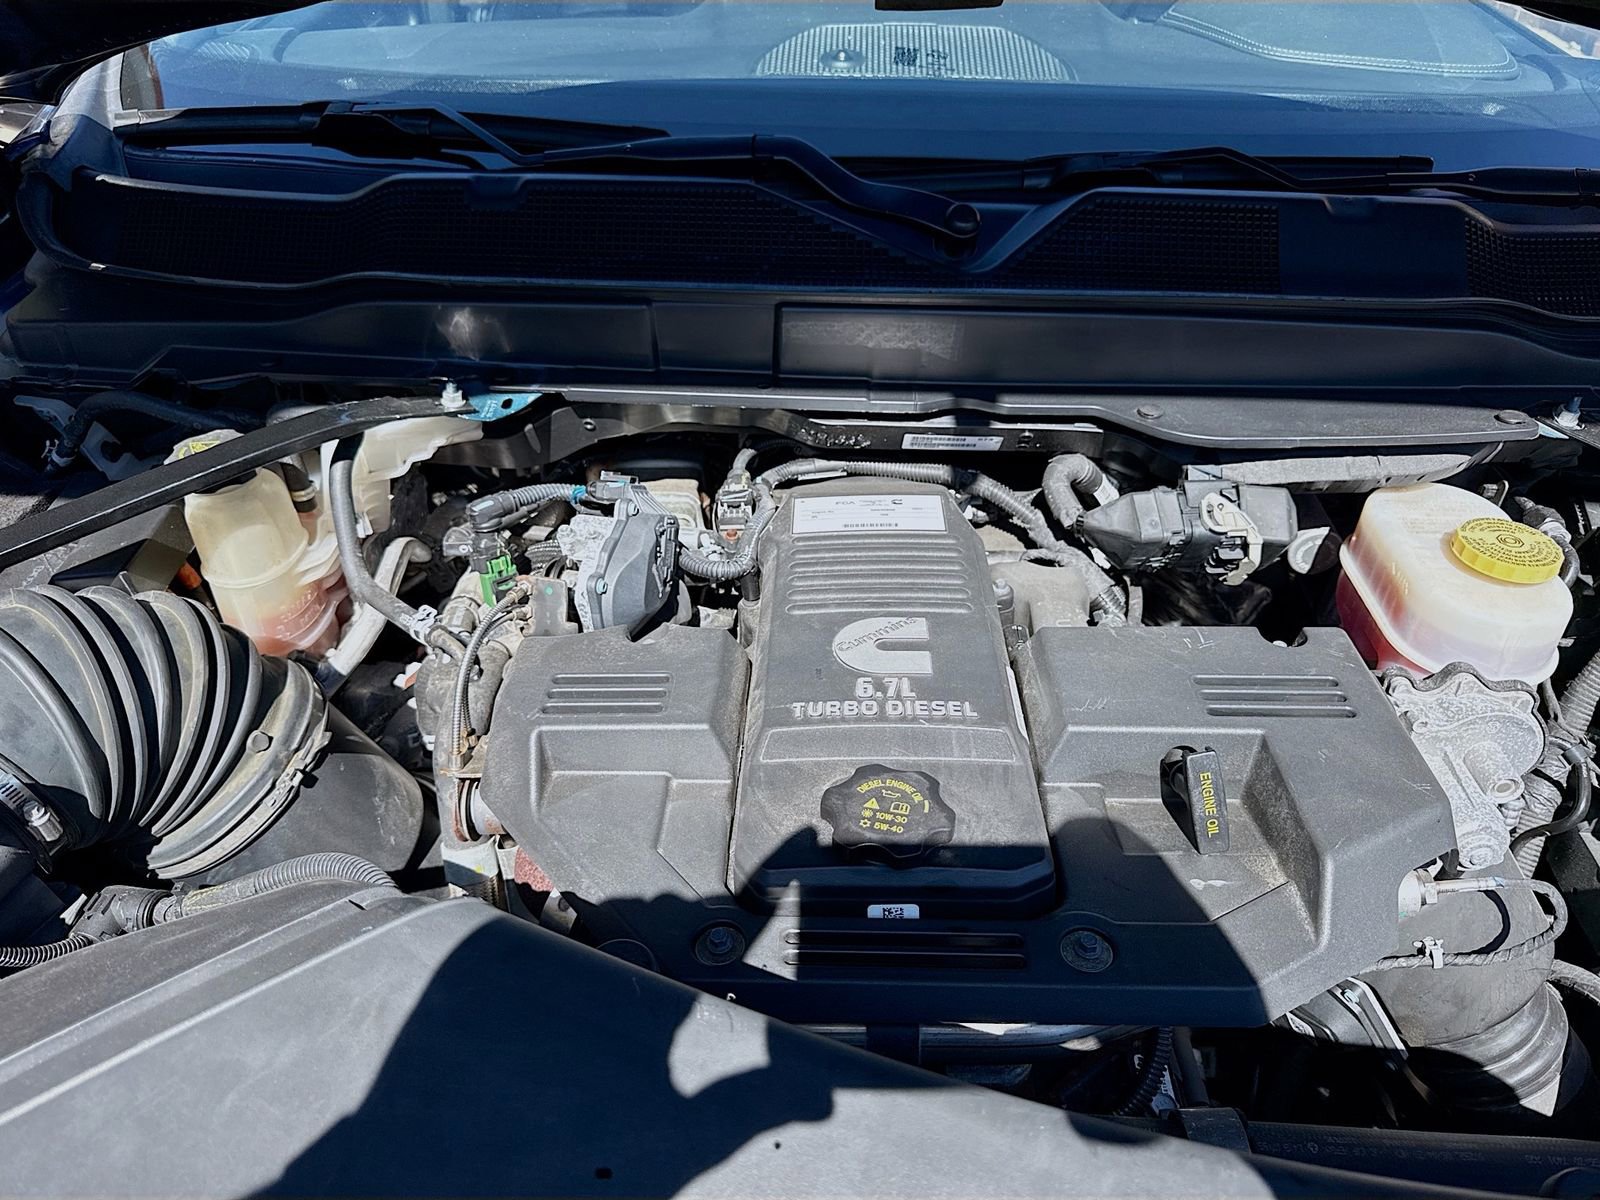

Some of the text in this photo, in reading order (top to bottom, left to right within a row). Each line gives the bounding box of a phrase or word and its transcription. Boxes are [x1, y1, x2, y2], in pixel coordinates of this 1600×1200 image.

[836, 616, 917, 652] Cummins
[855, 677, 917, 699] 6.7L
[792, 700, 979, 719] TURBO DIESEL
[856, 779, 885, 793] DIESEL
[887, 779, 916, 794] ENGINE
[1200, 772, 1220, 838] ENGINE OIL
[876, 812, 907, 823] 10W-30
[874, 822, 903, 833] 5W-40
